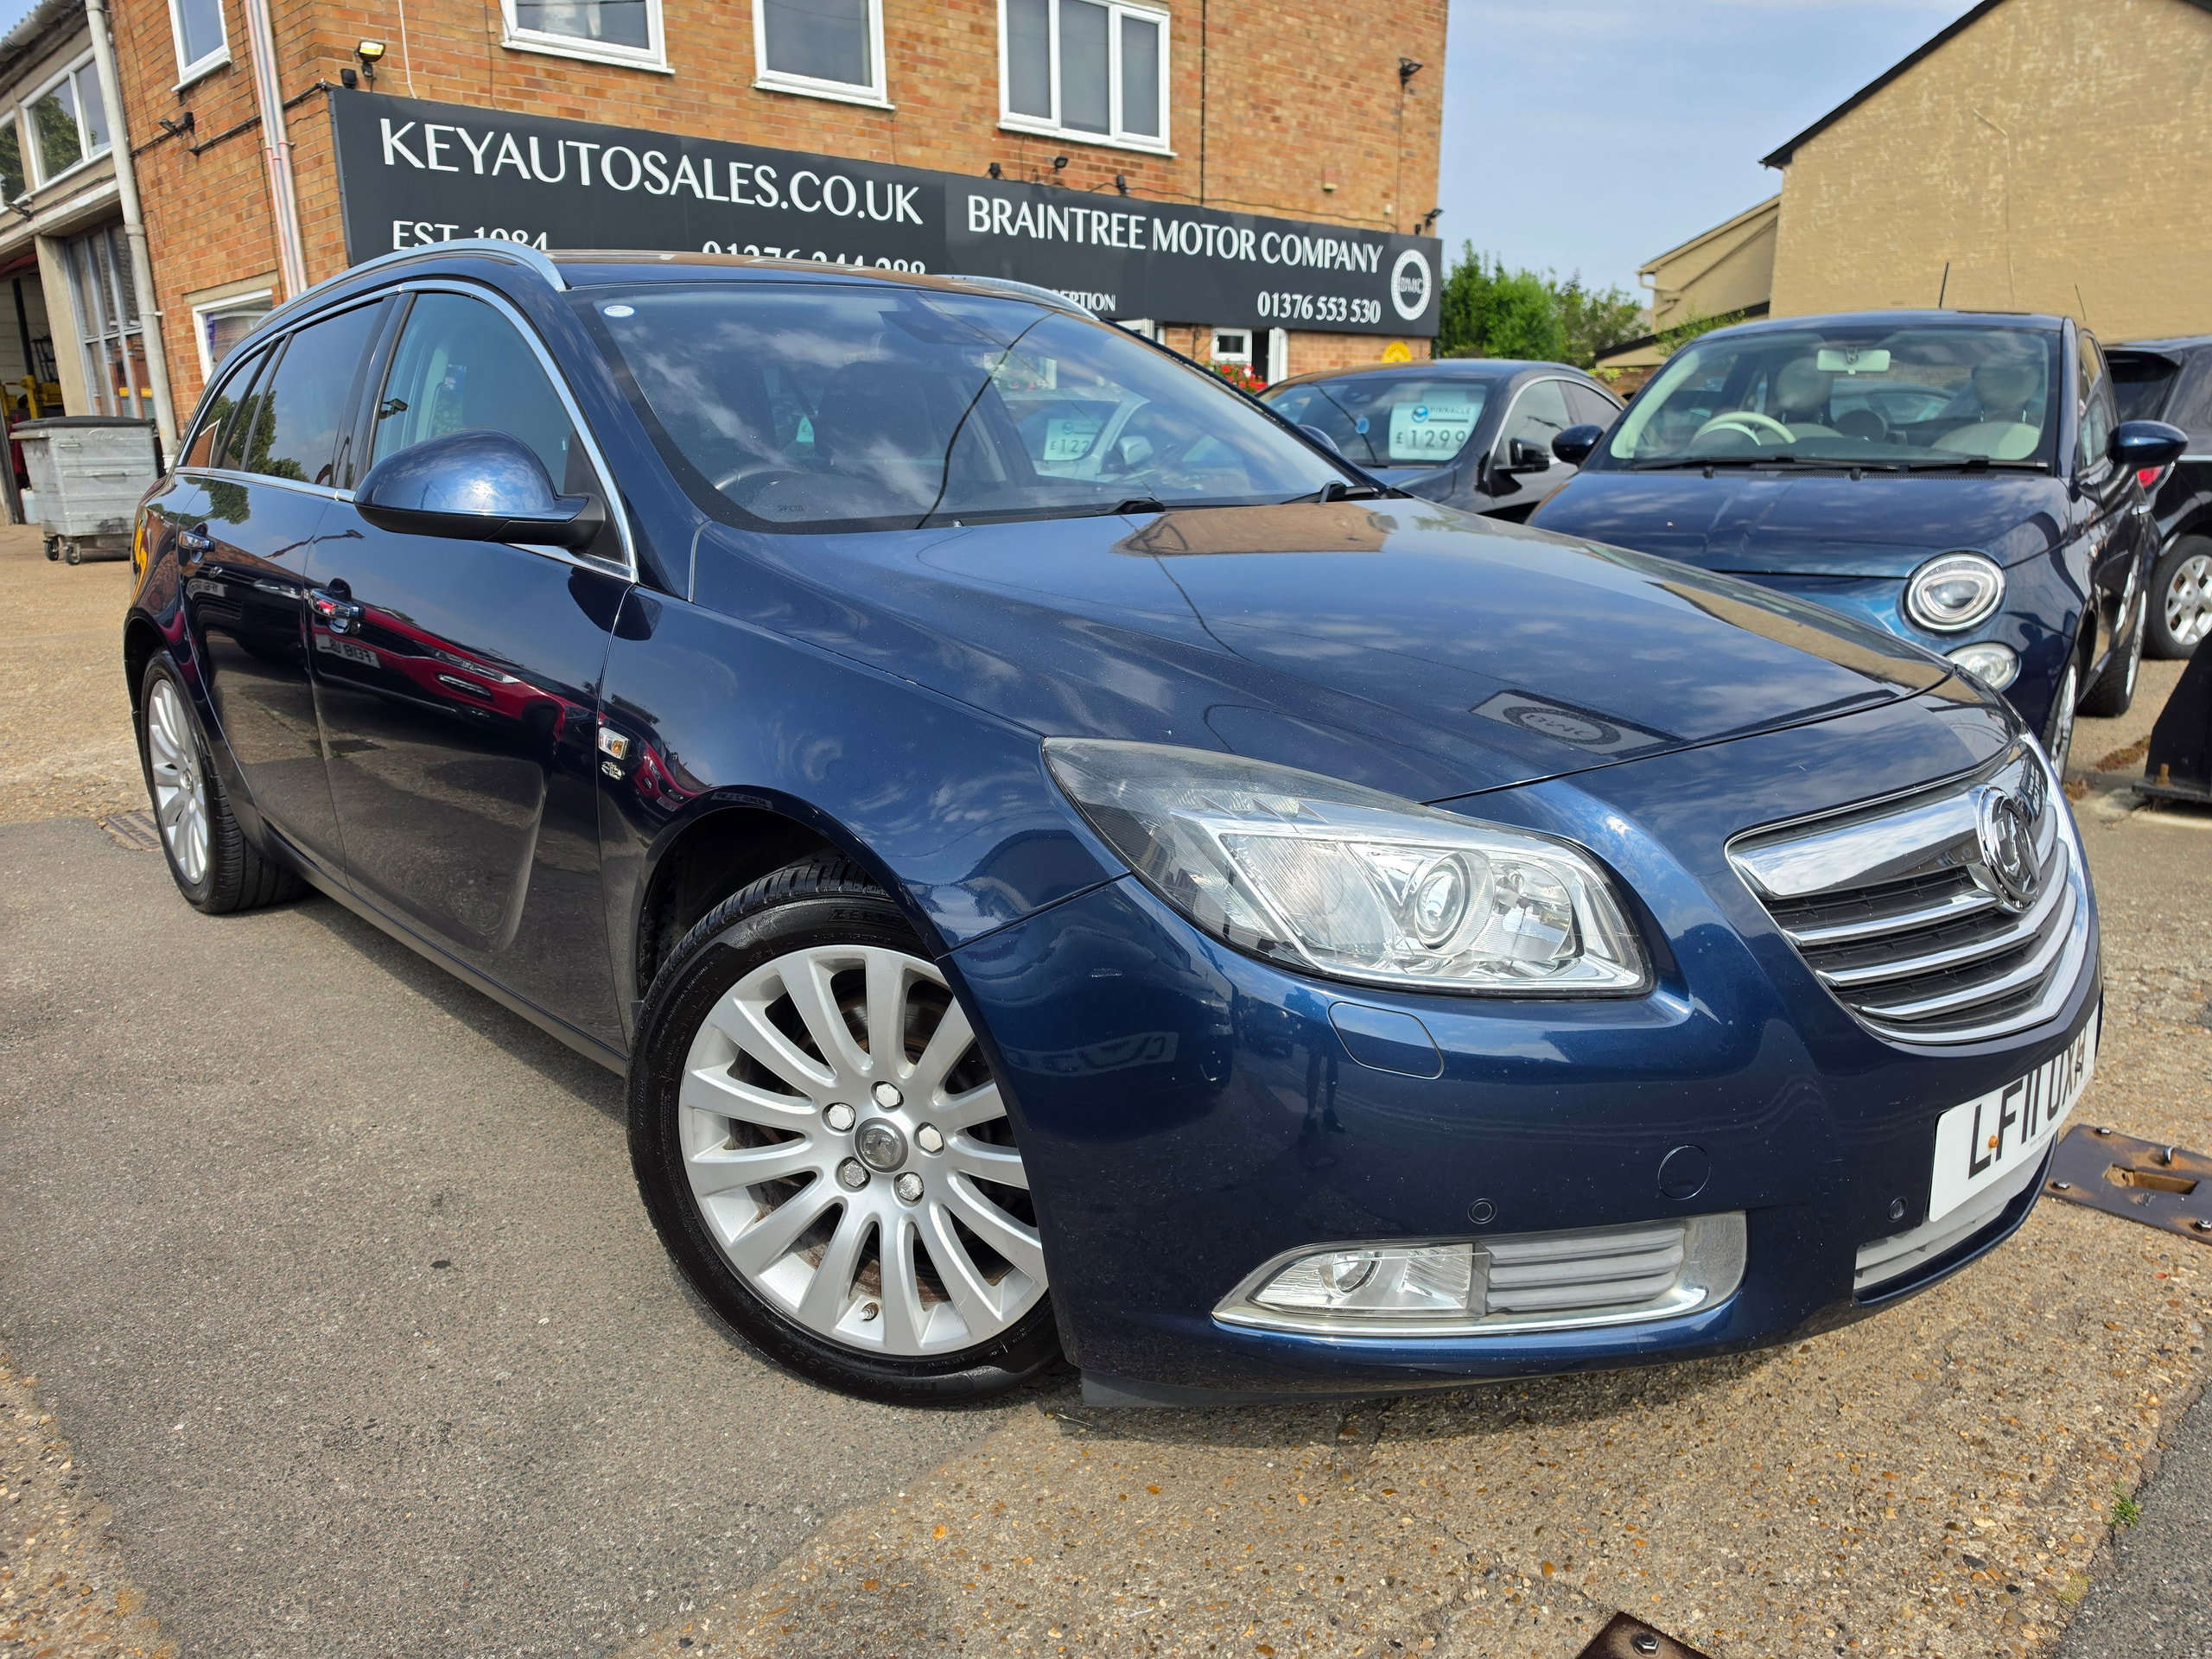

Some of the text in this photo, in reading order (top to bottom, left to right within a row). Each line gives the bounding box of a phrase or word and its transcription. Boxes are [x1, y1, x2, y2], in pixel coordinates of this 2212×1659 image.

[379, 118, 924, 226] KEYAUTOSALES.CO.UK
[967, 194, 1384, 274] BRAINTREE MOTOR COMPANY
[1257, 290, 1382, 324] 01376 553 530
